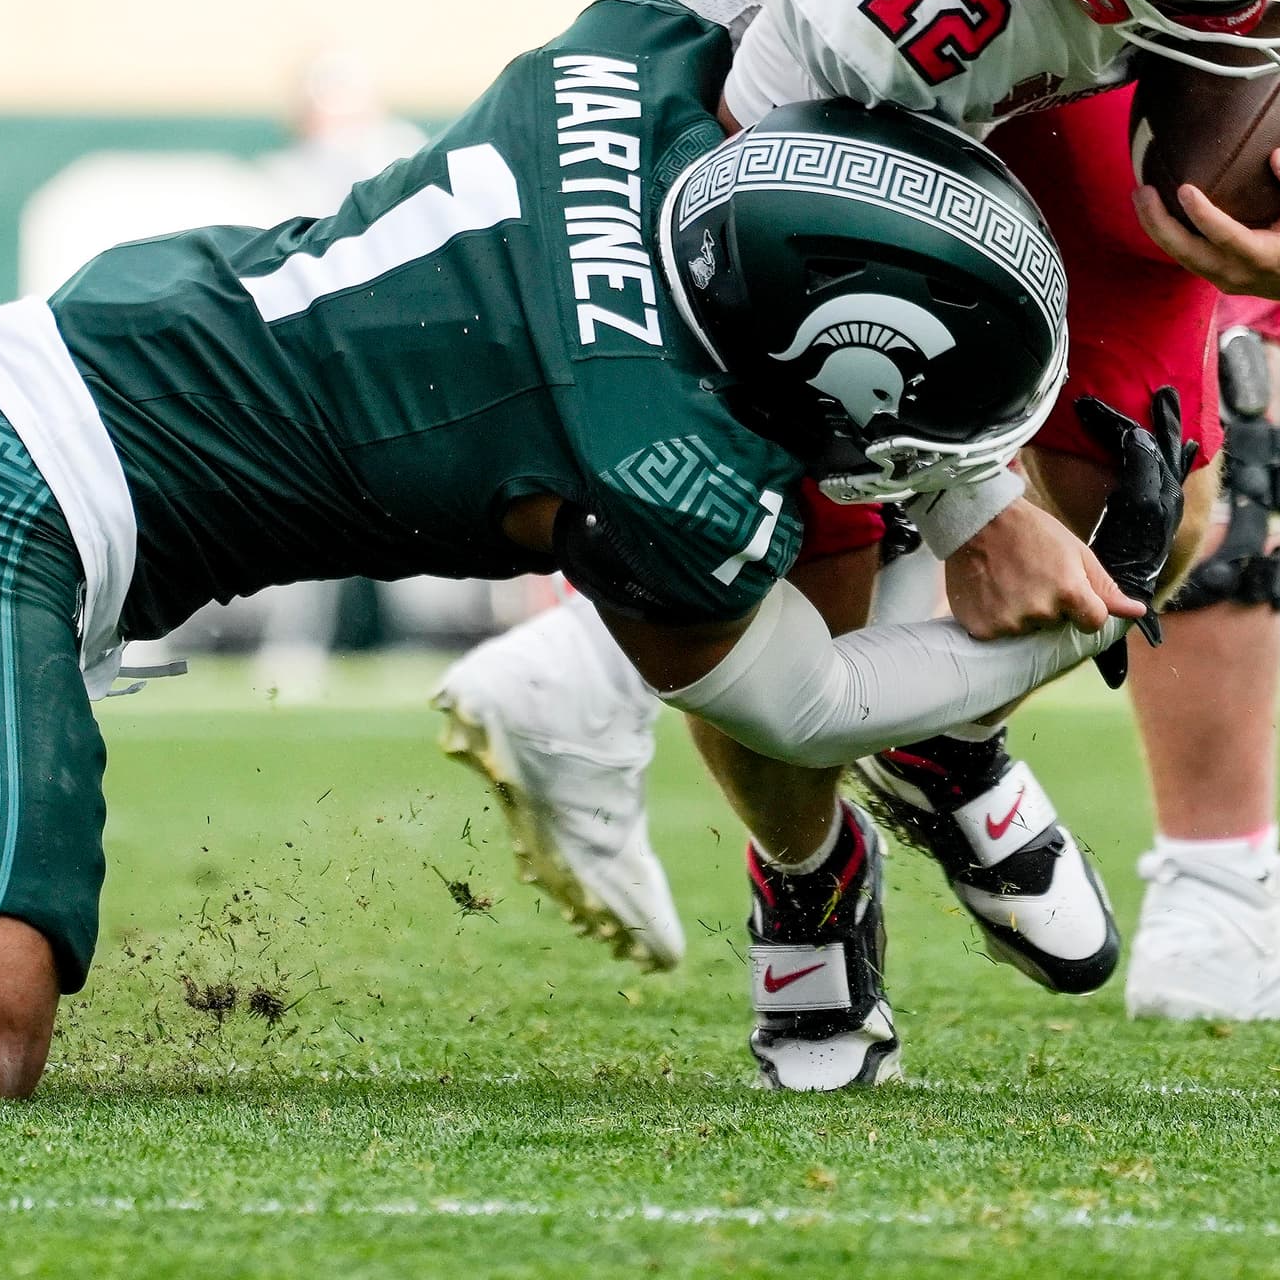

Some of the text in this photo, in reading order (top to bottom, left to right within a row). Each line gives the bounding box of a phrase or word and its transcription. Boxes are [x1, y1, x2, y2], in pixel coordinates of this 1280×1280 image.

[238, 142, 522, 323] 1
[552, 54, 664, 347] MARTINEZ
[710, 488, 784, 587] 1
